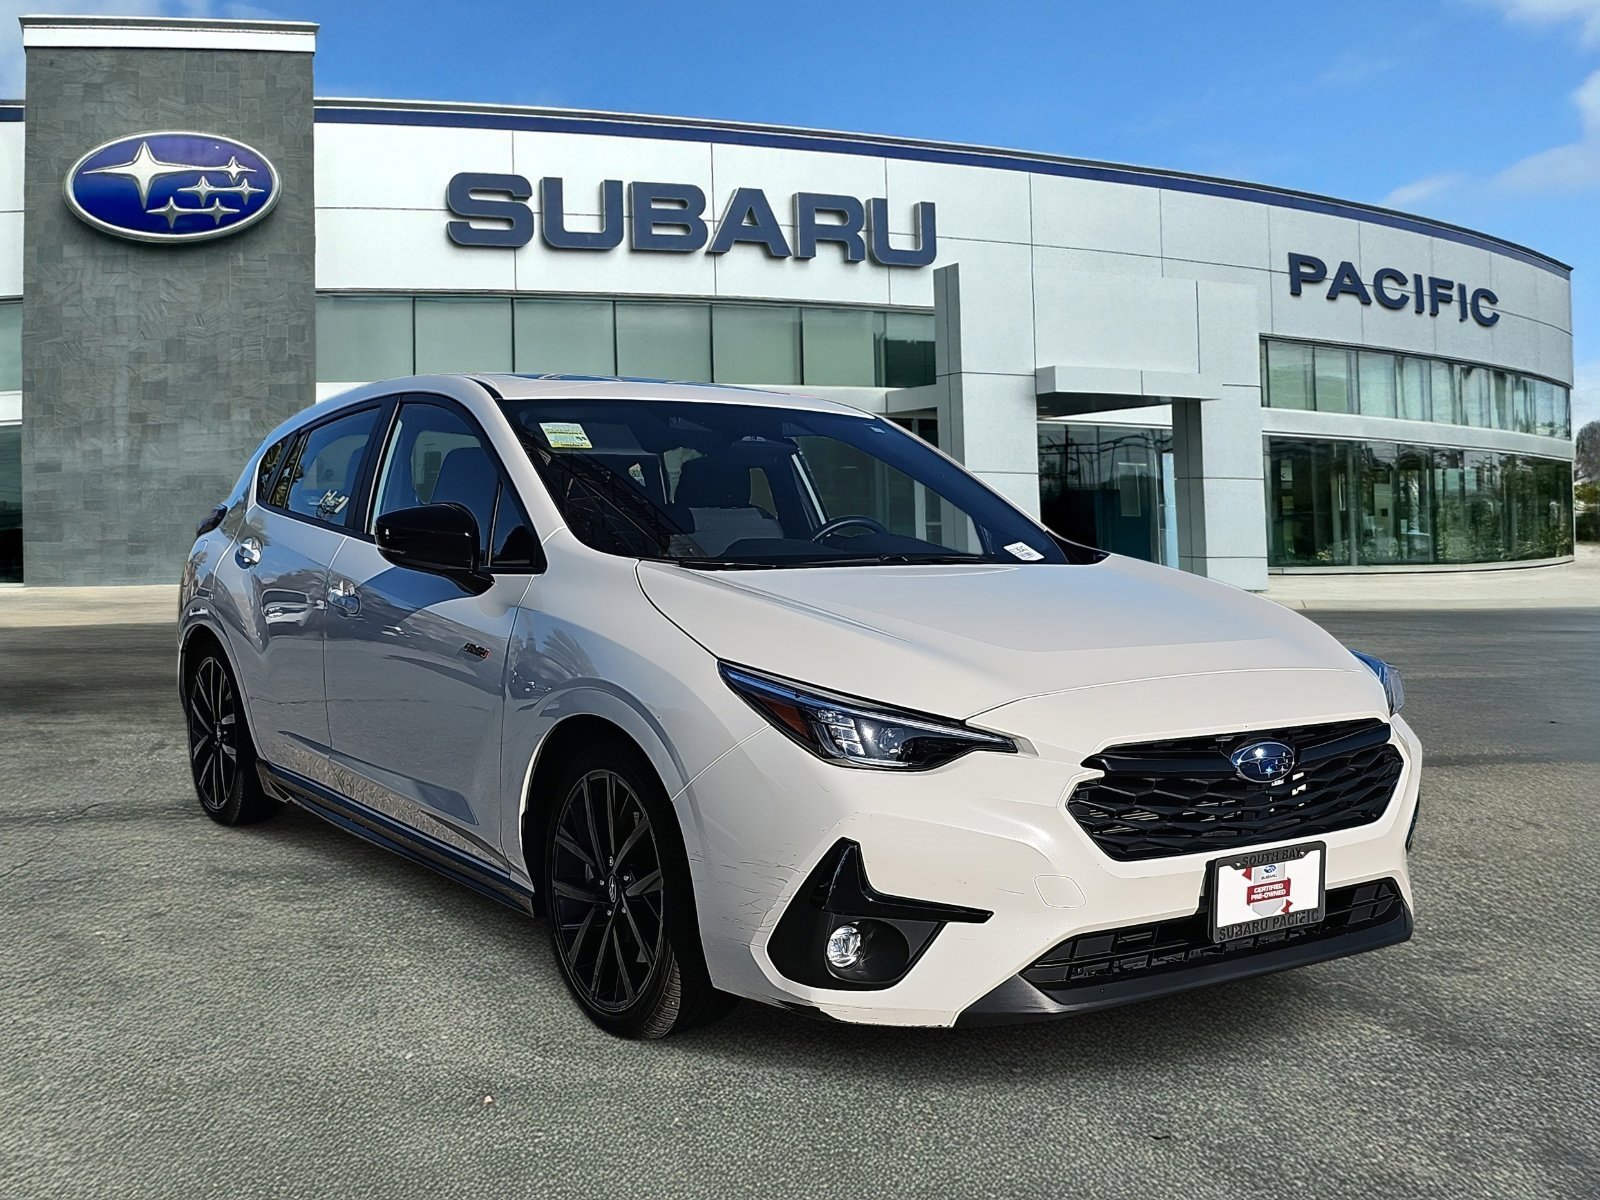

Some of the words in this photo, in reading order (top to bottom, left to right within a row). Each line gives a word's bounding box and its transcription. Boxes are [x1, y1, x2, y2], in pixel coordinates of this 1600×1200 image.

[446, 172, 937, 268] SUBARU
[1288, 252, 1500, 327] PACIFIC
[1242, 853, 1279, 866] SOUTH
[1282, 847, 1303, 860] BAY
[1251, 889, 1286, 900] PRE-OWNED
[1254, 883, 1283, 894] CERTIFIED
[1219, 920, 1268, 940] SUBARU
[1273, 909, 1319, 928] PACIFIC
